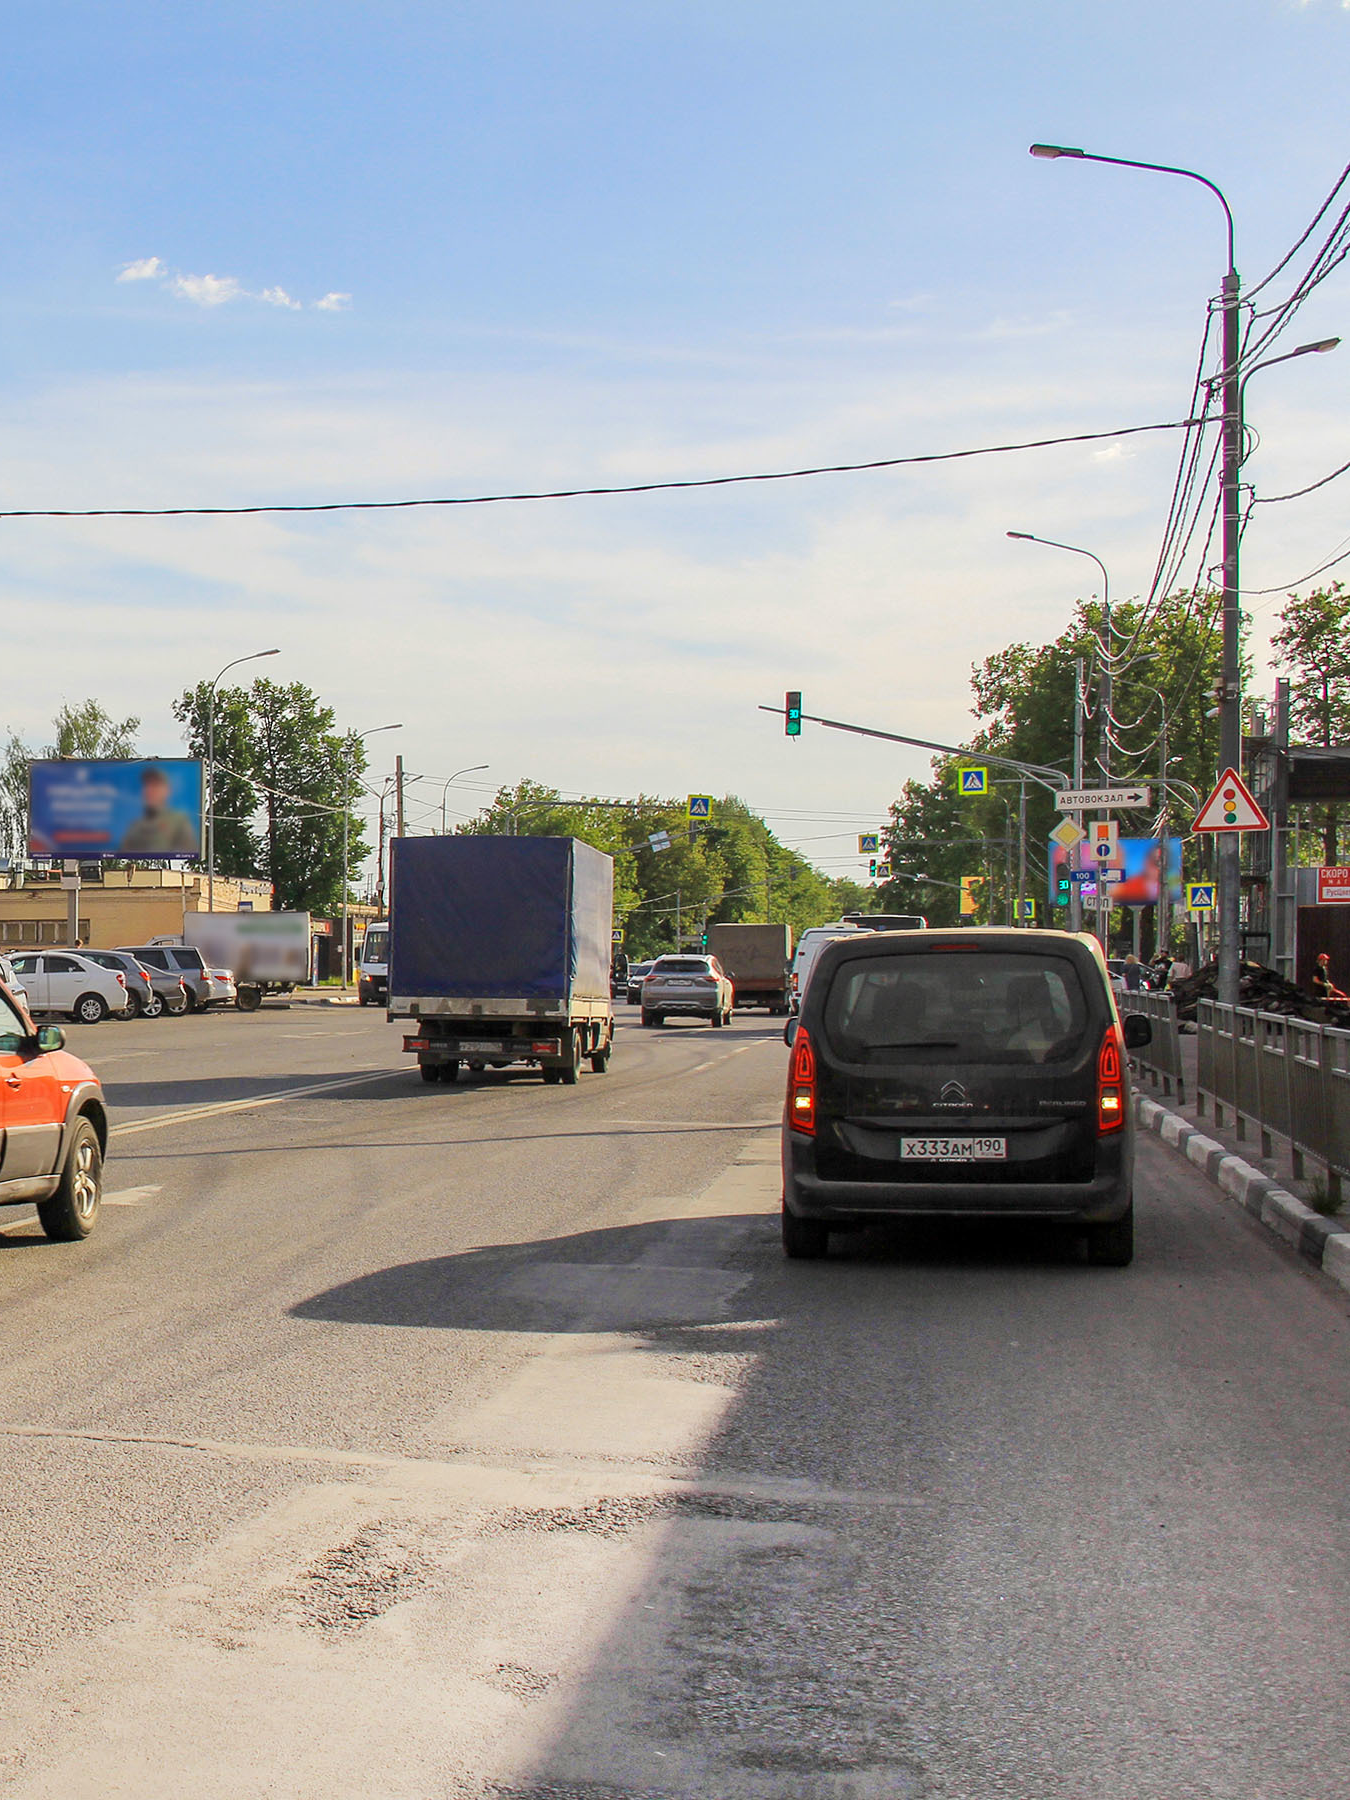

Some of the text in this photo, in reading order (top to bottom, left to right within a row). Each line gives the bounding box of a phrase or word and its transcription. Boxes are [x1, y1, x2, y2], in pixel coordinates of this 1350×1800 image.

[1060, 794, 1123, 805] АВТОВОКЗАЛ
[1075, 872, 1090, 880] 100
[1058, 880, 1069, 890] 30
[906, 1139, 1001, 1156] Х333АМ 190
